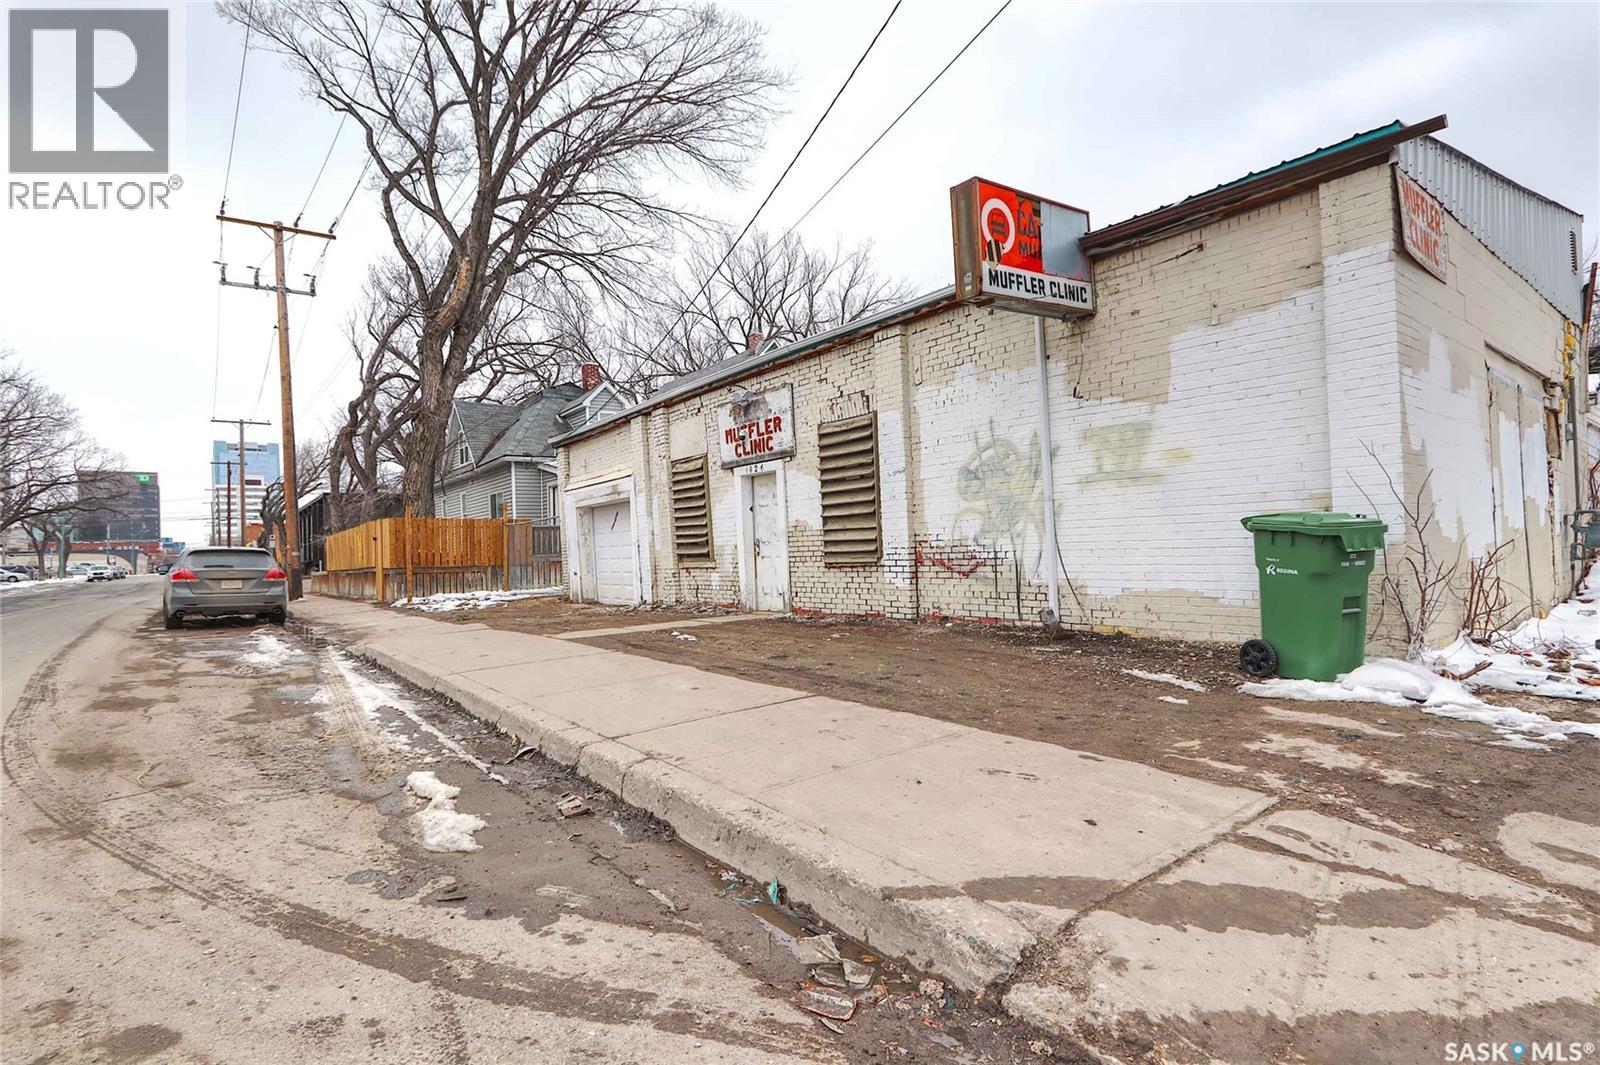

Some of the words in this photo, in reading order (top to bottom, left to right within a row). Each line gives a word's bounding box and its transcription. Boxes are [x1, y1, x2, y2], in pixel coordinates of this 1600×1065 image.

[1402, 179, 1440, 237] MUFFLER
[1409, 218, 1441, 268] CLINIC
[988, 269, 1046, 297] MUFFLER
[1050, 281, 1088, 304] CLINIC
[735, 435, 773, 458] CLINIC
